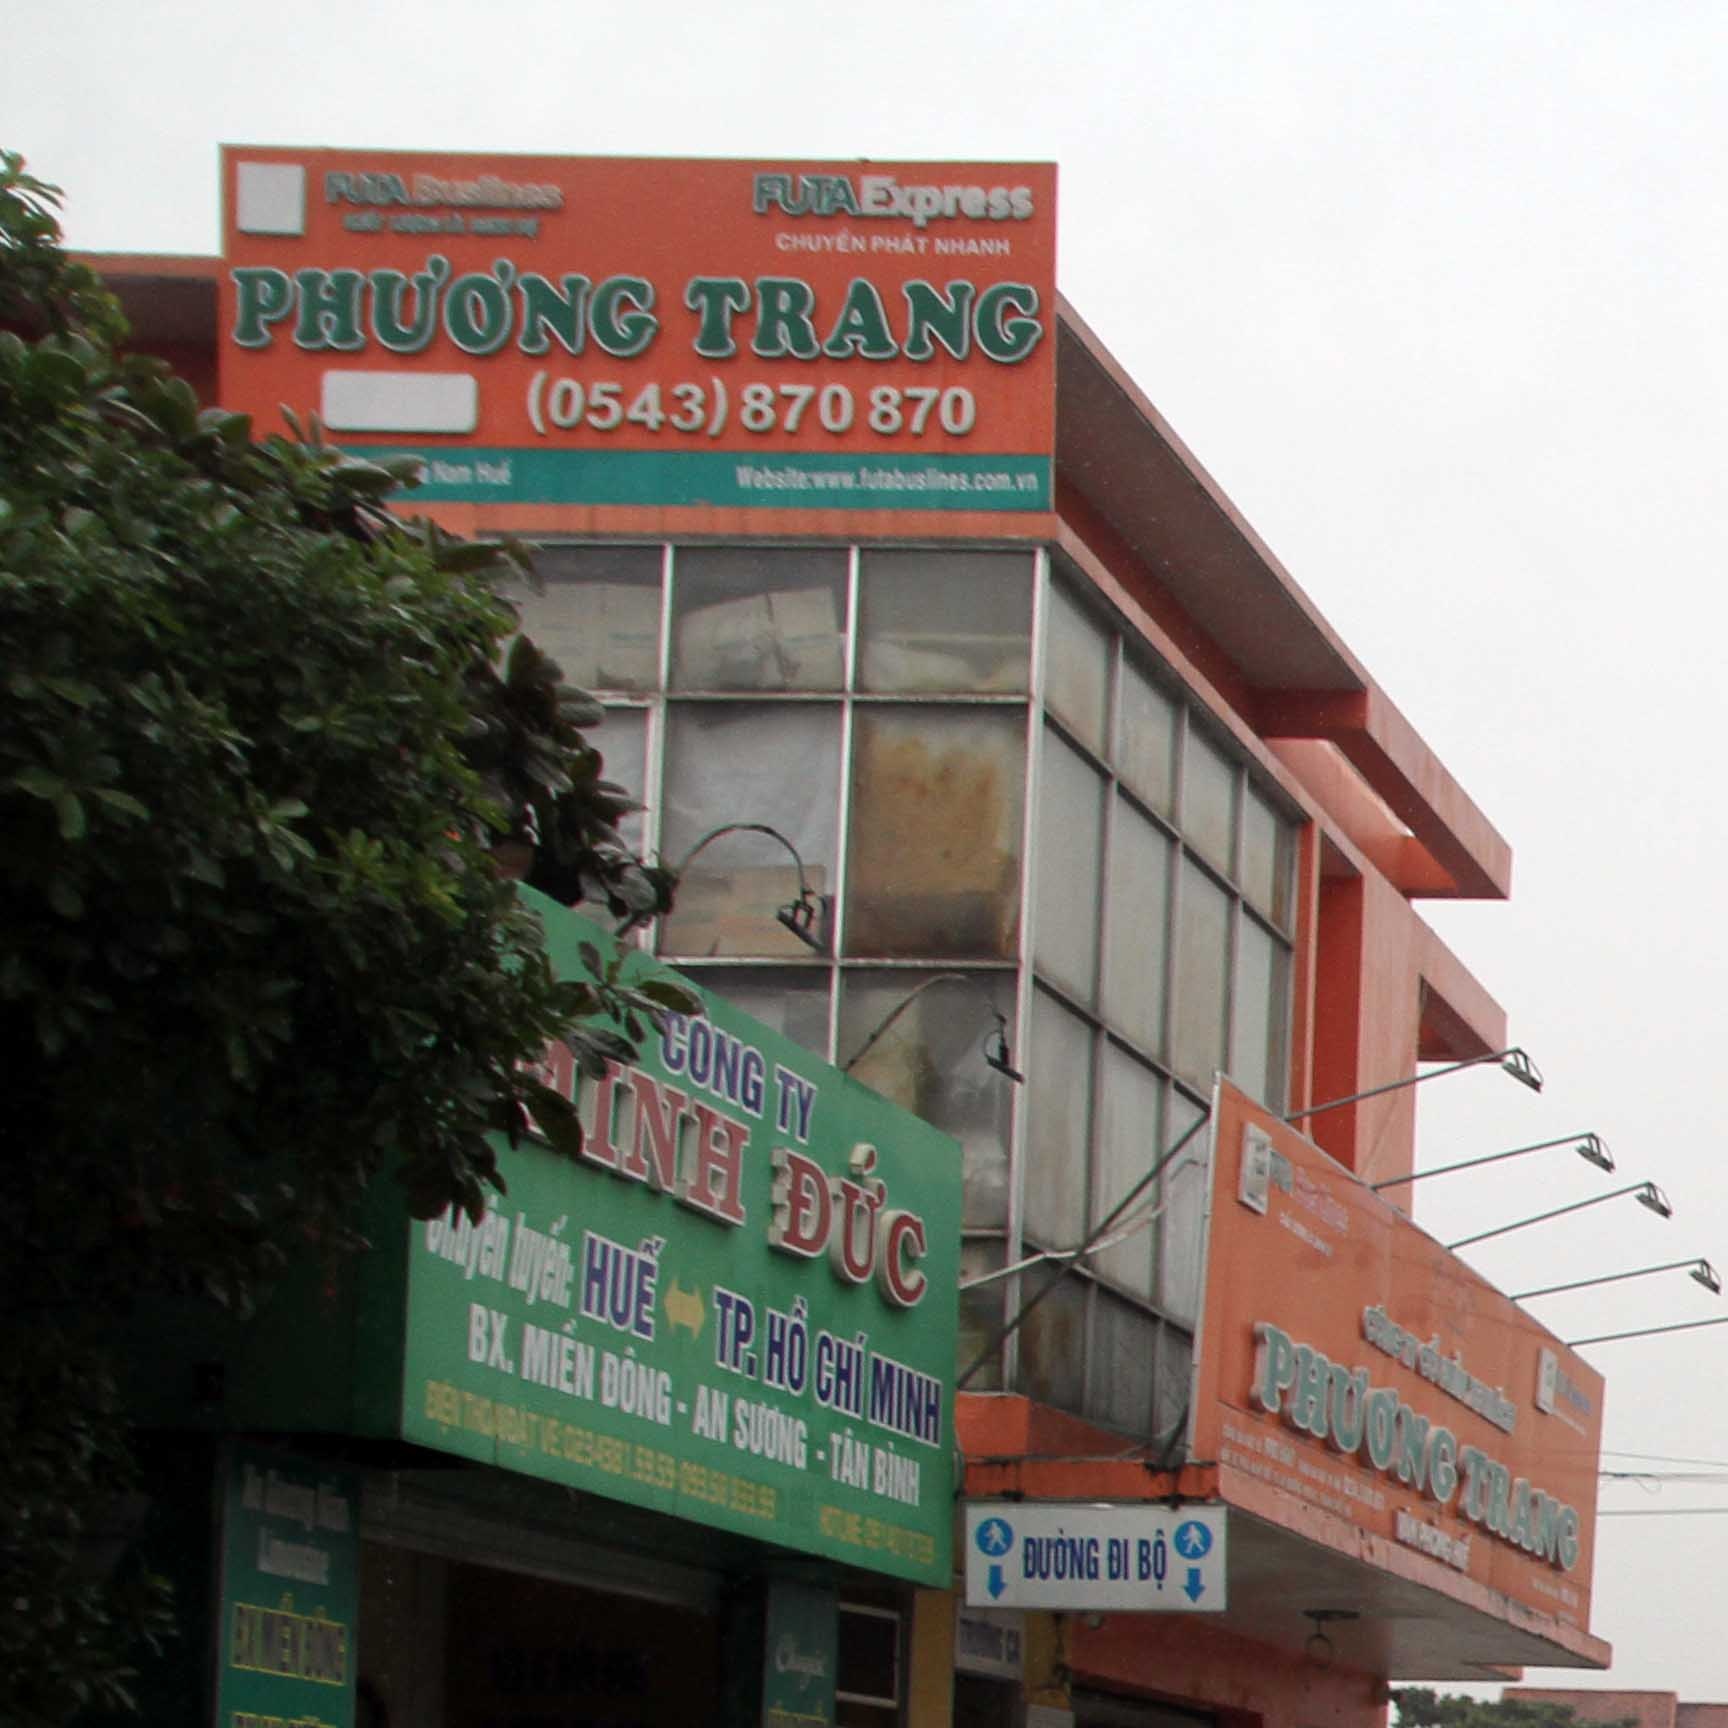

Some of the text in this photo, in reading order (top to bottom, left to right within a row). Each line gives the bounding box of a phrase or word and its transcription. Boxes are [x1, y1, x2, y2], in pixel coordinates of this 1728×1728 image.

[872, 231, 928, 252] PHÁT
[935, 237, 1011, 256] NHANH
[232, 254, 1043, 364] PHƯƠNG TRANG
[527, 371, 977, 438] (0543) 870 870
[774, 1066, 818, 1145] TY
[768, 1142, 929, 1309] ĐỨC
[580, 1228, 668, 1343] HUẾ
[713, 1284, 758, 1381] TP.
[766, 1294, 810, 1397] HỒ
[815, 1331, 866, 1419] CHÍ
[868, 1350, 943, 1448] MINH
[467, 1302, 515, 1375] BX.
[520, 1317, 596, 1402] MIỀN
[600, 1348, 672, 1427] ĐÔNG
[692, 1383, 728, 1443] AN
[733, 1396, 808, 1471] SƯƠNG
[829, 1424, 870, 1490] TÂN
[873, 1440, 921, 1507] BÌNH
[1251, 1320, 1458, 1504] PHƯƠNG
[1461, 1445, 1581, 1572] TRANG
[1107, 1538, 1129, 1581] ĐI
[1137, 1529, 1167, 1591] BỘ
